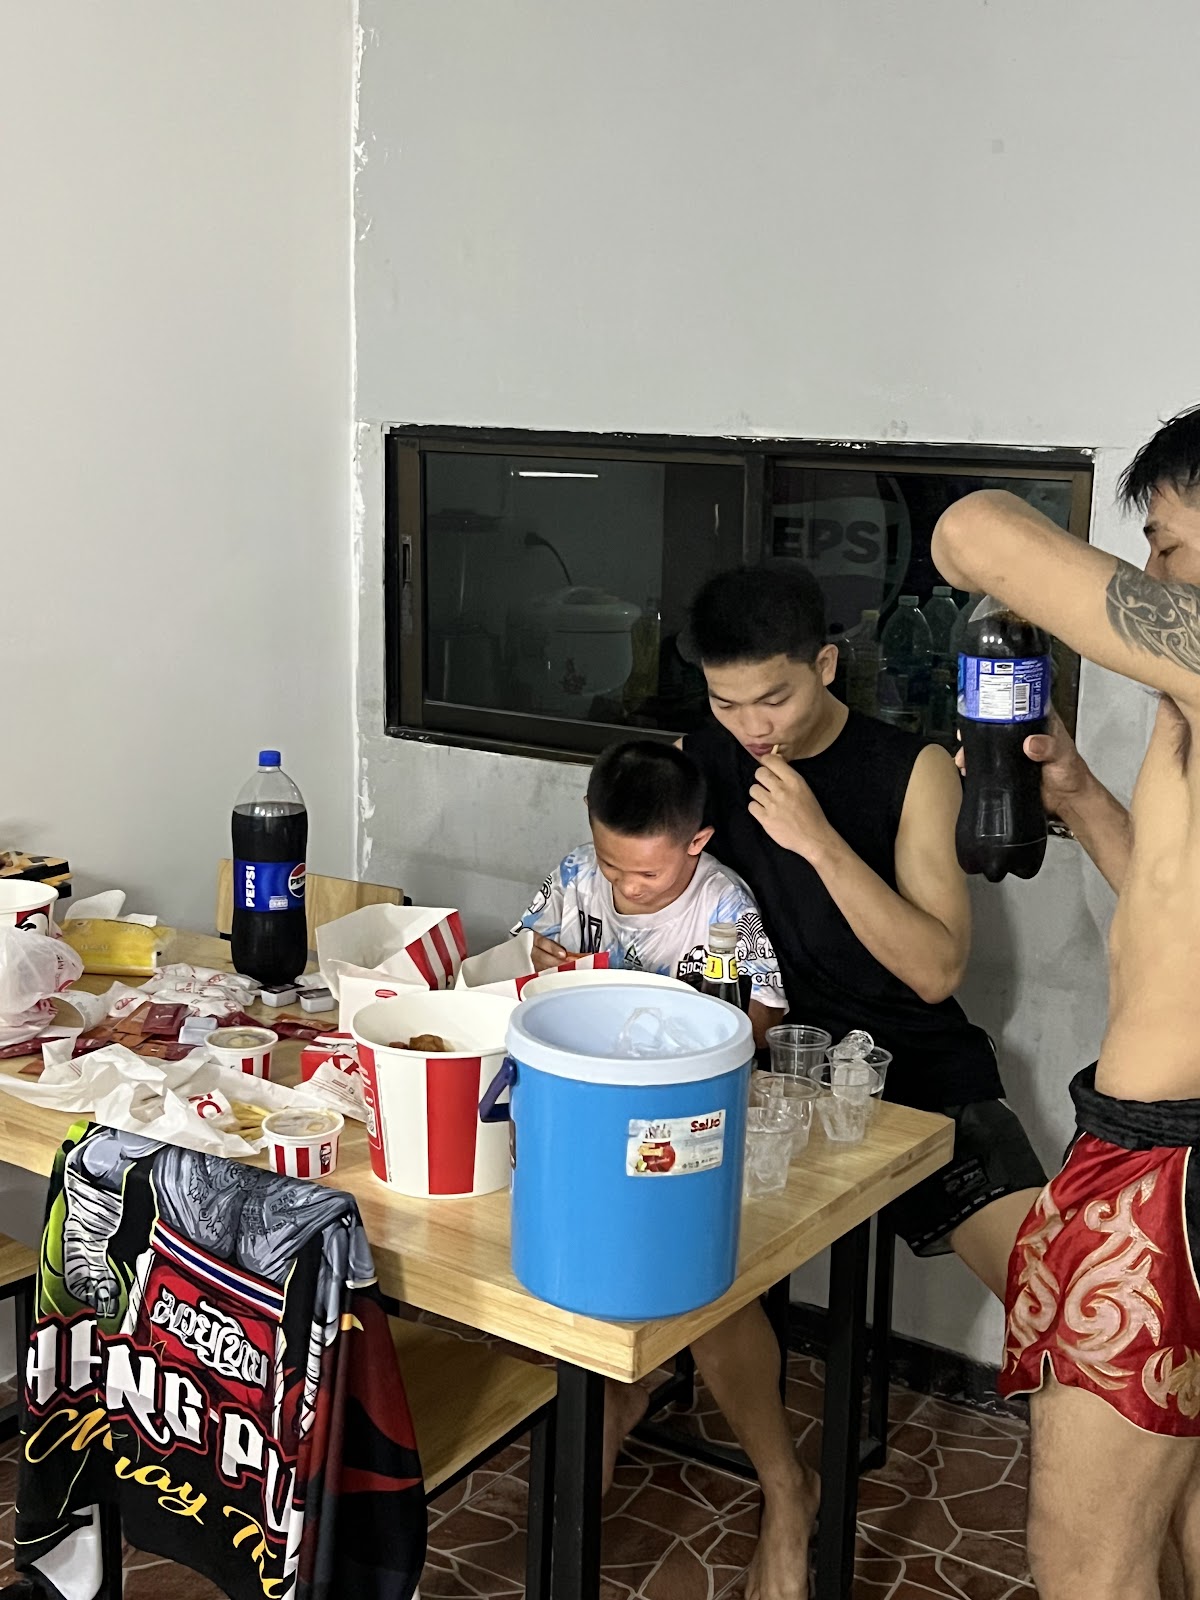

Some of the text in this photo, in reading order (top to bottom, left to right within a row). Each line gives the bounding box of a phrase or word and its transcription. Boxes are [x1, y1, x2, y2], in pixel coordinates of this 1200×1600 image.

[245, 865, 256, 908] PEPSI
[150, 1287, 269, 1389] มวยไทย
